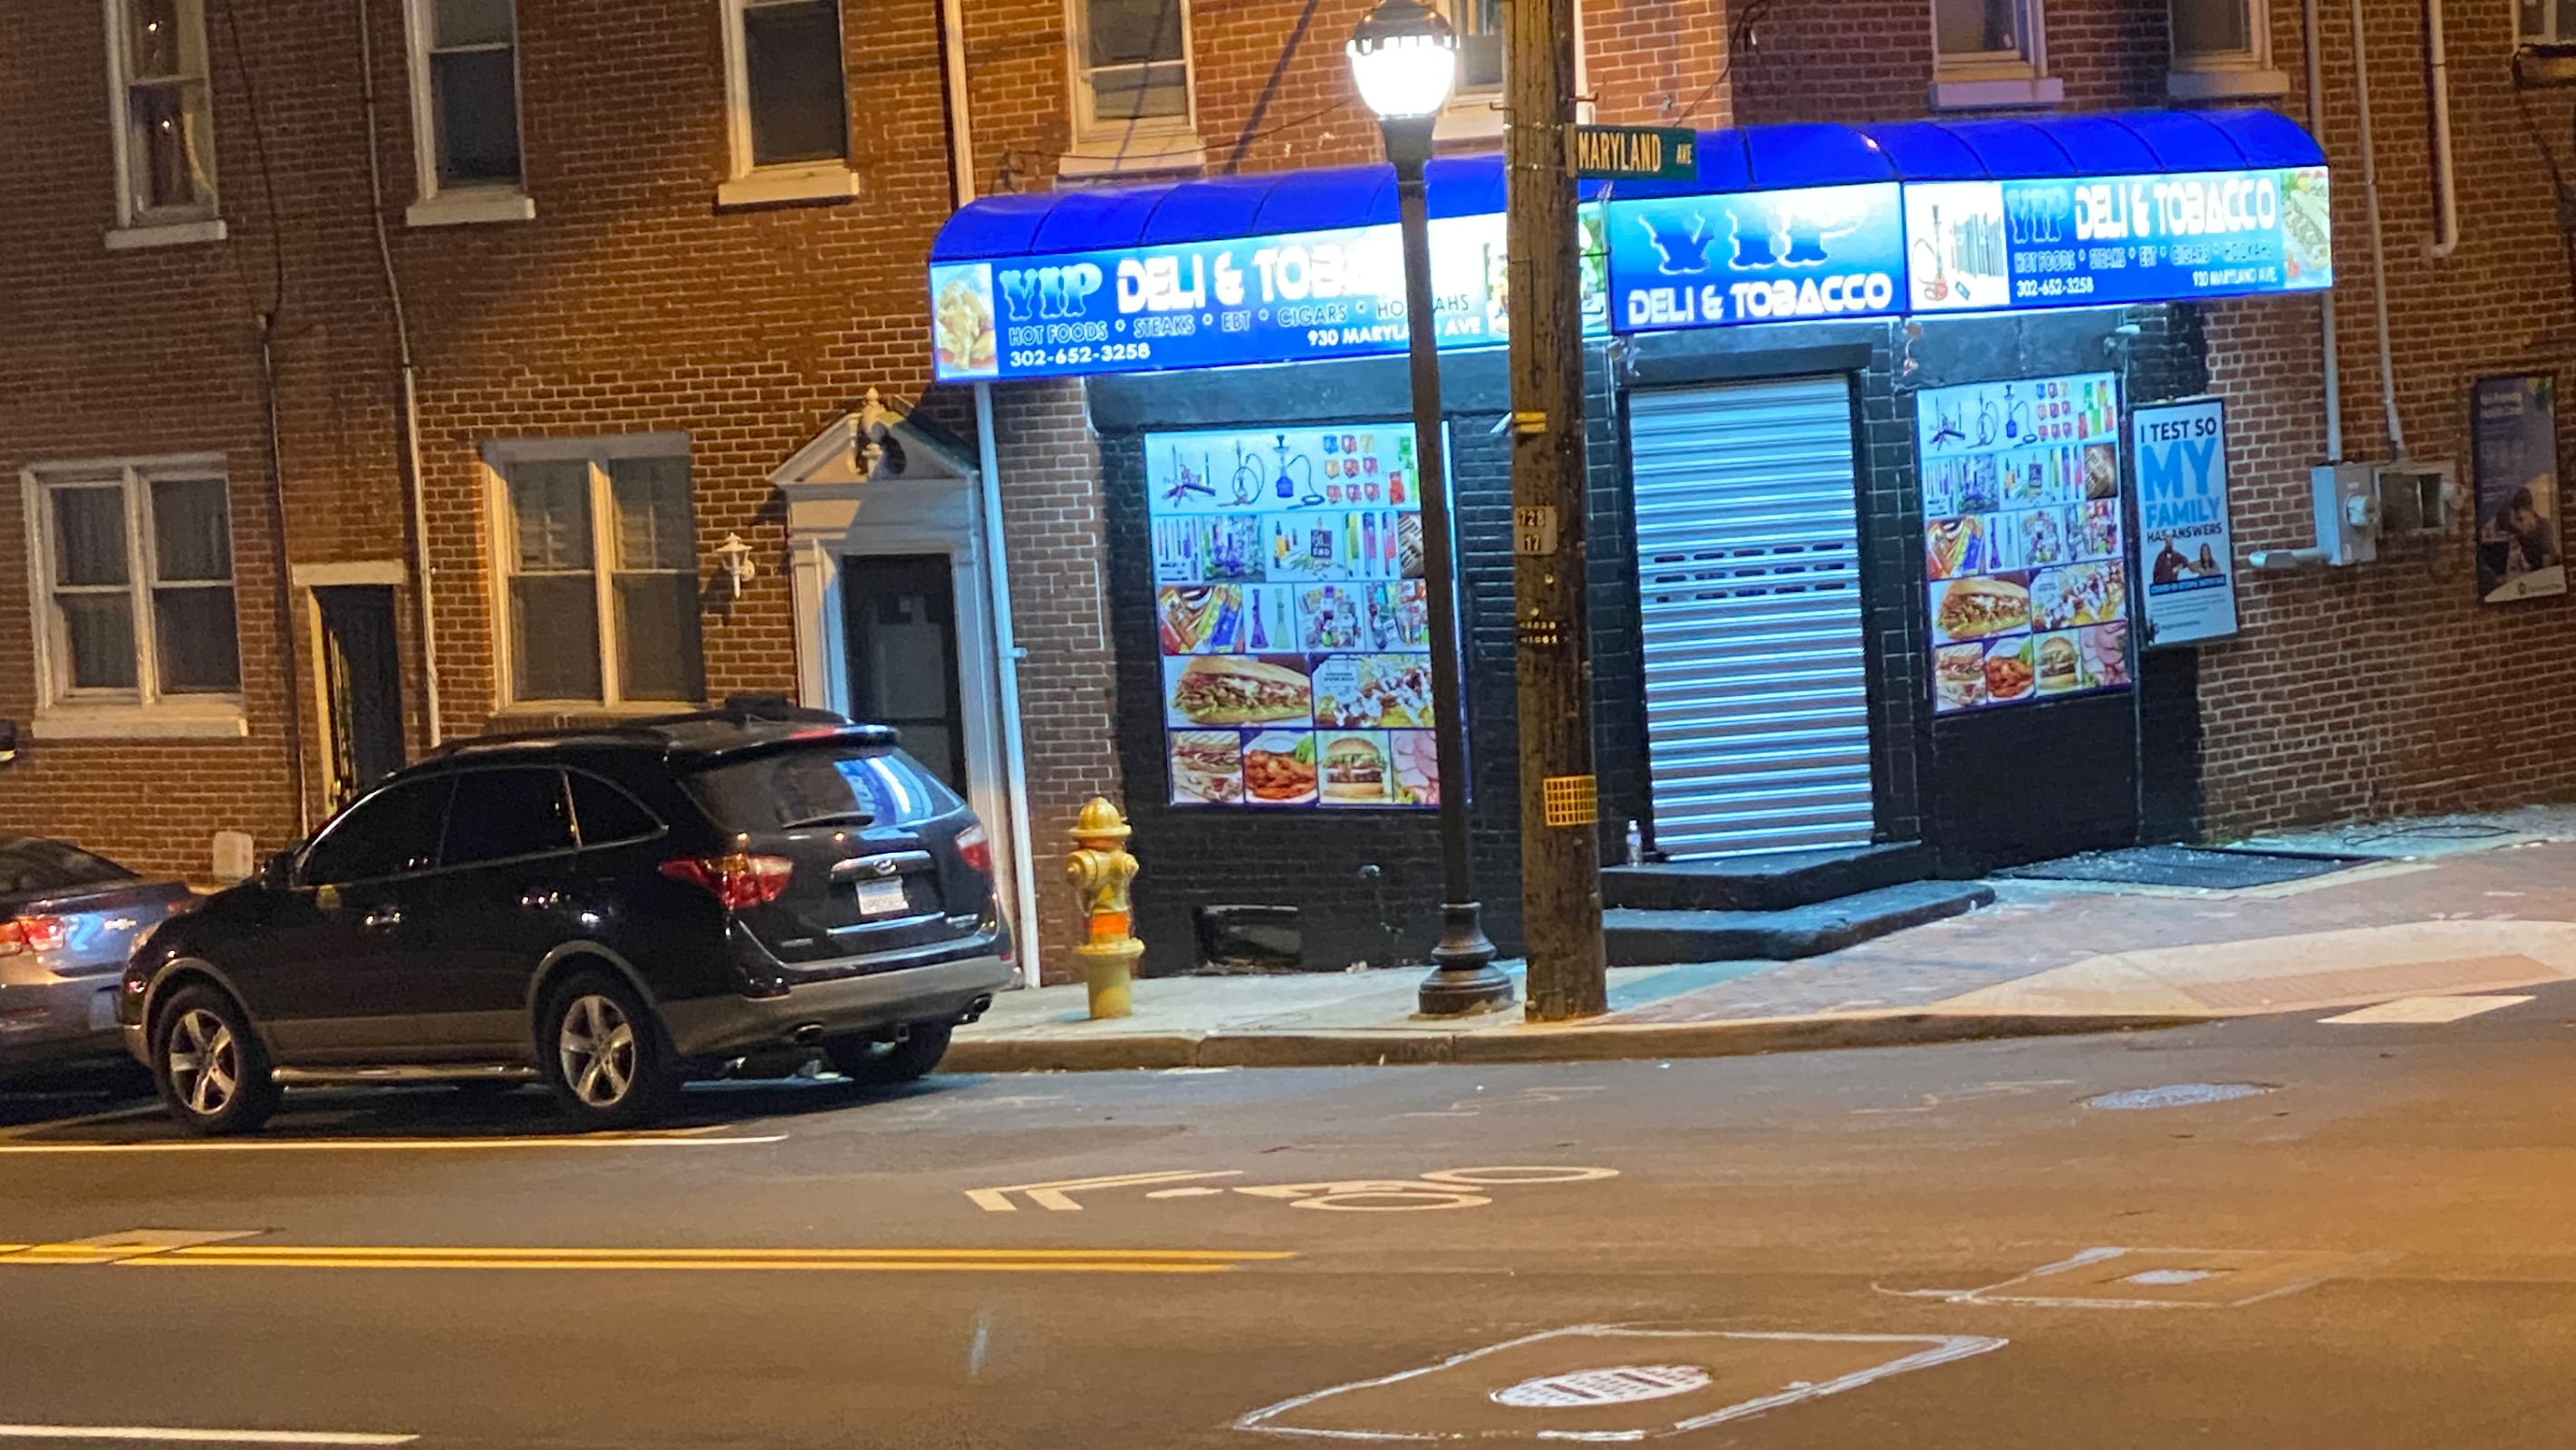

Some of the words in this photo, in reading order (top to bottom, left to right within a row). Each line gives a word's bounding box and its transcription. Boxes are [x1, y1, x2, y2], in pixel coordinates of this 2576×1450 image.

[1578, 131, 1662, 172] MARYLAND
[1676, 143, 1693, 164] AVE
[2005, 186, 2070, 245] VIP
[2075, 183, 2128, 240] DELI
[2131, 183, 2151, 237] &
[2153, 178, 2277, 236] TOBACCO
[2013, 252, 2037, 274] HOT
[2039, 249, 2076, 273] FOODS
[999, 263, 1103, 321] VIP
[1117, 254, 1206, 314] DELI
[1214, 252, 1245, 306] &
[1628, 285, 1694, 324] DELI
[1702, 285, 1724, 320] &
[1729, 273, 1893, 318] TOBACCO
[2017, 276, 2094, 298] 302-652-3258
[1008, 324, 1044, 346] HOT
[1047, 321, 1108, 344] FOODS
[1134, 314, 1195, 338] STEAKS
[1221, 310, 1250, 332] EBT
[1278, 304, 1348, 328] CIGARS
[1376, 294, 1470, 319] HOAHS
[1307, 328, 1339, 346] 930
[1444, 316, 1481, 336] AVE
[1009, 343, 1151, 367] 302-652-3258
[2140, 424, 2145, 443] I
[2150, 420, 2190, 441] TEST
[2195, 416, 2216, 437] SO
[2141, 438, 2216, 501] MY
[2145, 497, 2222, 528] FAMILY
[2147, 527, 2166, 543] HAS
[2172, 522, 2223, 540] ANSWERS
